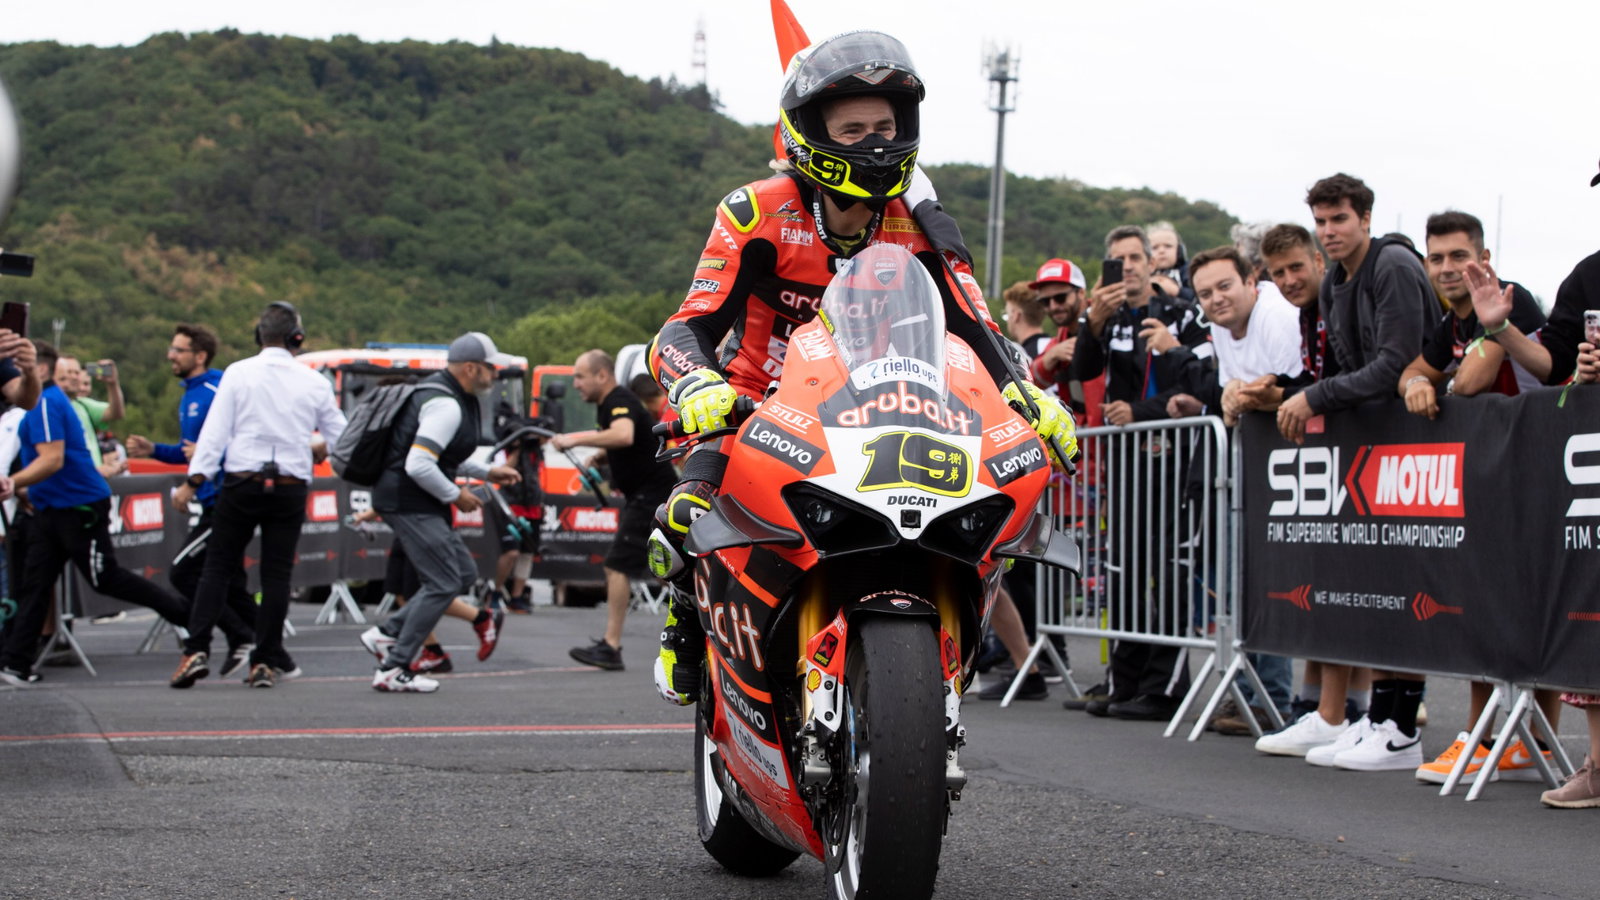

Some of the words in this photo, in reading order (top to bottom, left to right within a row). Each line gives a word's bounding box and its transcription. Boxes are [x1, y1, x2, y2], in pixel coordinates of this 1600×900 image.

[812, 202, 828, 240] DUCATI
[781, 227, 814, 246] FIAMM
[799, 328, 834, 362] FIAMM
[883, 358, 920, 375] riello
[920, 366, 938, 383] ups
[769, 404, 813, 429] STULZ
[837, 381, 973, 437] aruba.it
[749, 423, 812, 464] Lenovo
[988, 421, 1025, 443] STULZ
[856, 431, 973, 498] 19
[991, 447, 1042, 479] Lenovo
[1375, 454, 1460, 507] MOTUL
[887, 495, 937, 508] DUCATI
[1267, 522, 1284, 542] FIM
[1286, 522, 1339, 544] SUPERBIKE
[1341, 522, 1378, 545] WORLD
[1381, 524, 1465, 548] CHAMPIONSHIP
[1565, 525, 1591, 550] FIM
[1314, 590, 1328, 605] WE
[1329, 592, 1352, 607] MAKE
[1353, 593, 1406, 611] EXCITEMENT
[720, 668, 767, 731] Lenovo
